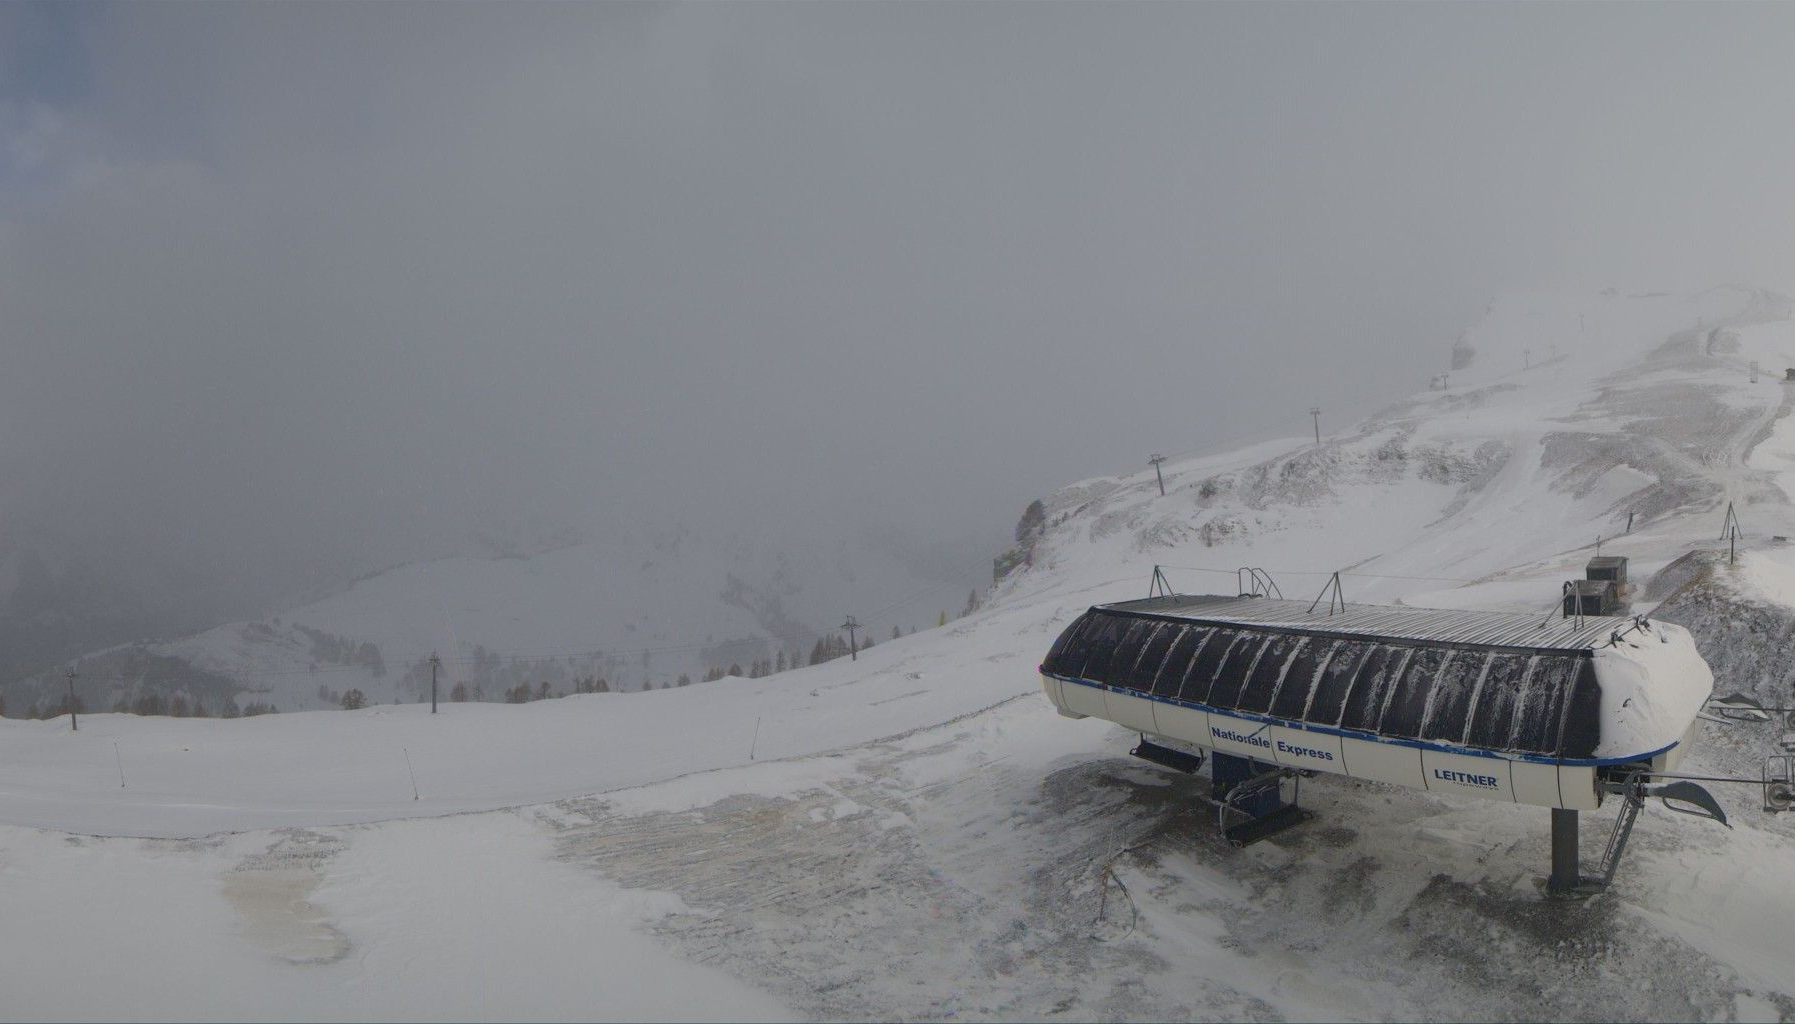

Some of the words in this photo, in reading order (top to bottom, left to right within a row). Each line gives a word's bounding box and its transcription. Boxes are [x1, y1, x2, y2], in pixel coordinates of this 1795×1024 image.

[1212, 727, 1270, 748] Nationale
[1277, 741, 1333, 761] Express
[1434, 769, 1498, 787] LEITNER
